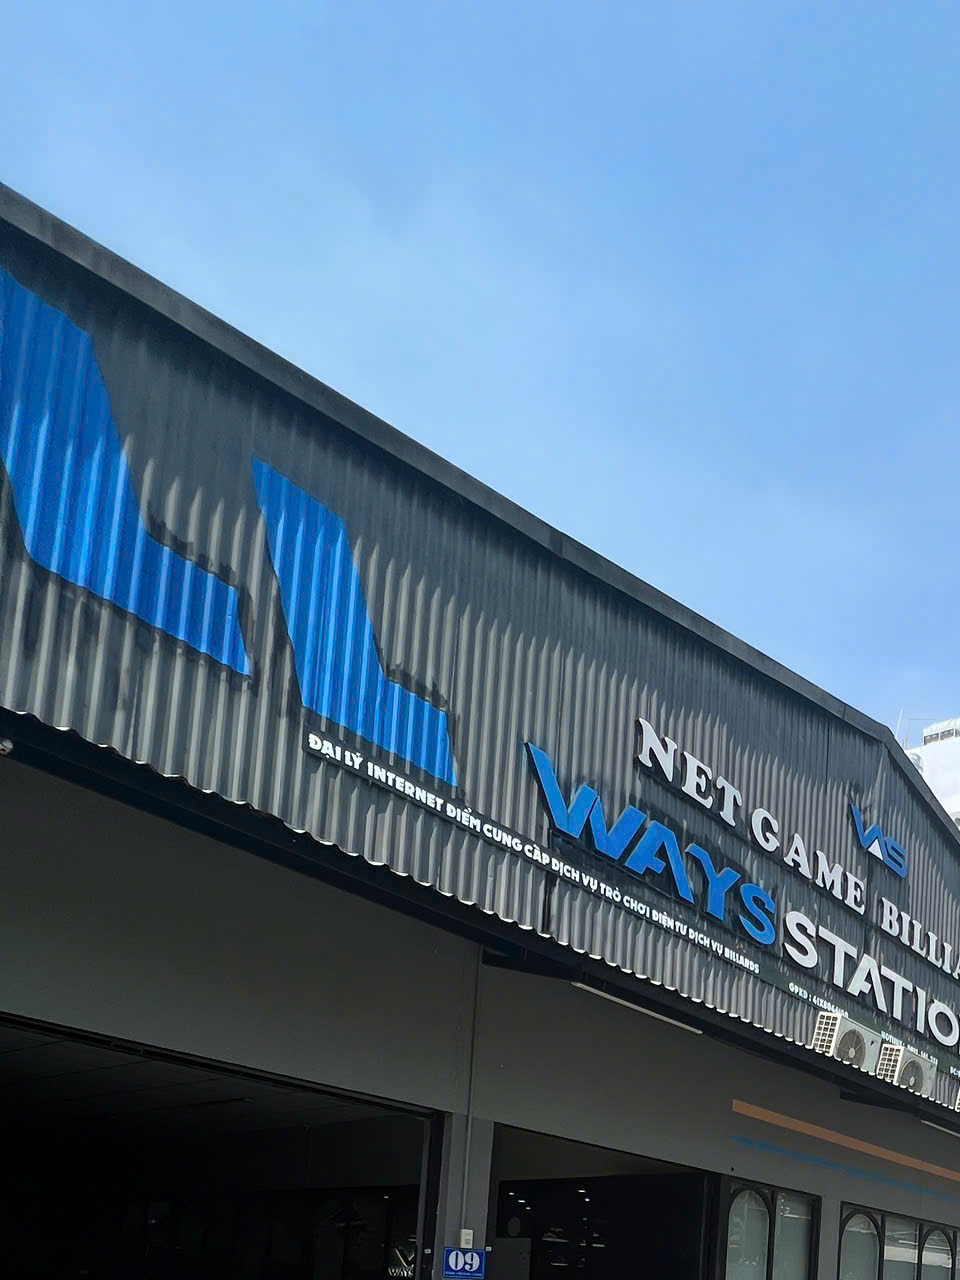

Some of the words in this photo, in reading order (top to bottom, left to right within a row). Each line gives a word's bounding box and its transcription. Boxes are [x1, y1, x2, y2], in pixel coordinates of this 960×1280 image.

[308, 733, 341, 765] ĐẠI
[344, 751, 364, 771] LÝ
[366, 761, 445, 812] INTERNET
[446, 802, 481, 833] ĐIỂM
[482, 823, 523, 852] CUNG
[551, 857, 580, 883] DỊCH
[581, 872, 598, 892] VỤ
[600, 882, 621, 903] TRÒ
[623, 896, 650, 918] CHƠI
[711, 939, 724, 956] VỤ
[724, 946, 760, 974] BILLARDS
[524, 742, 776, 946] WAYS
[638, 717, 744, 827] NET
[751, 808, 866, 916] GAME
[448, 1250, 481, 1272] 09
